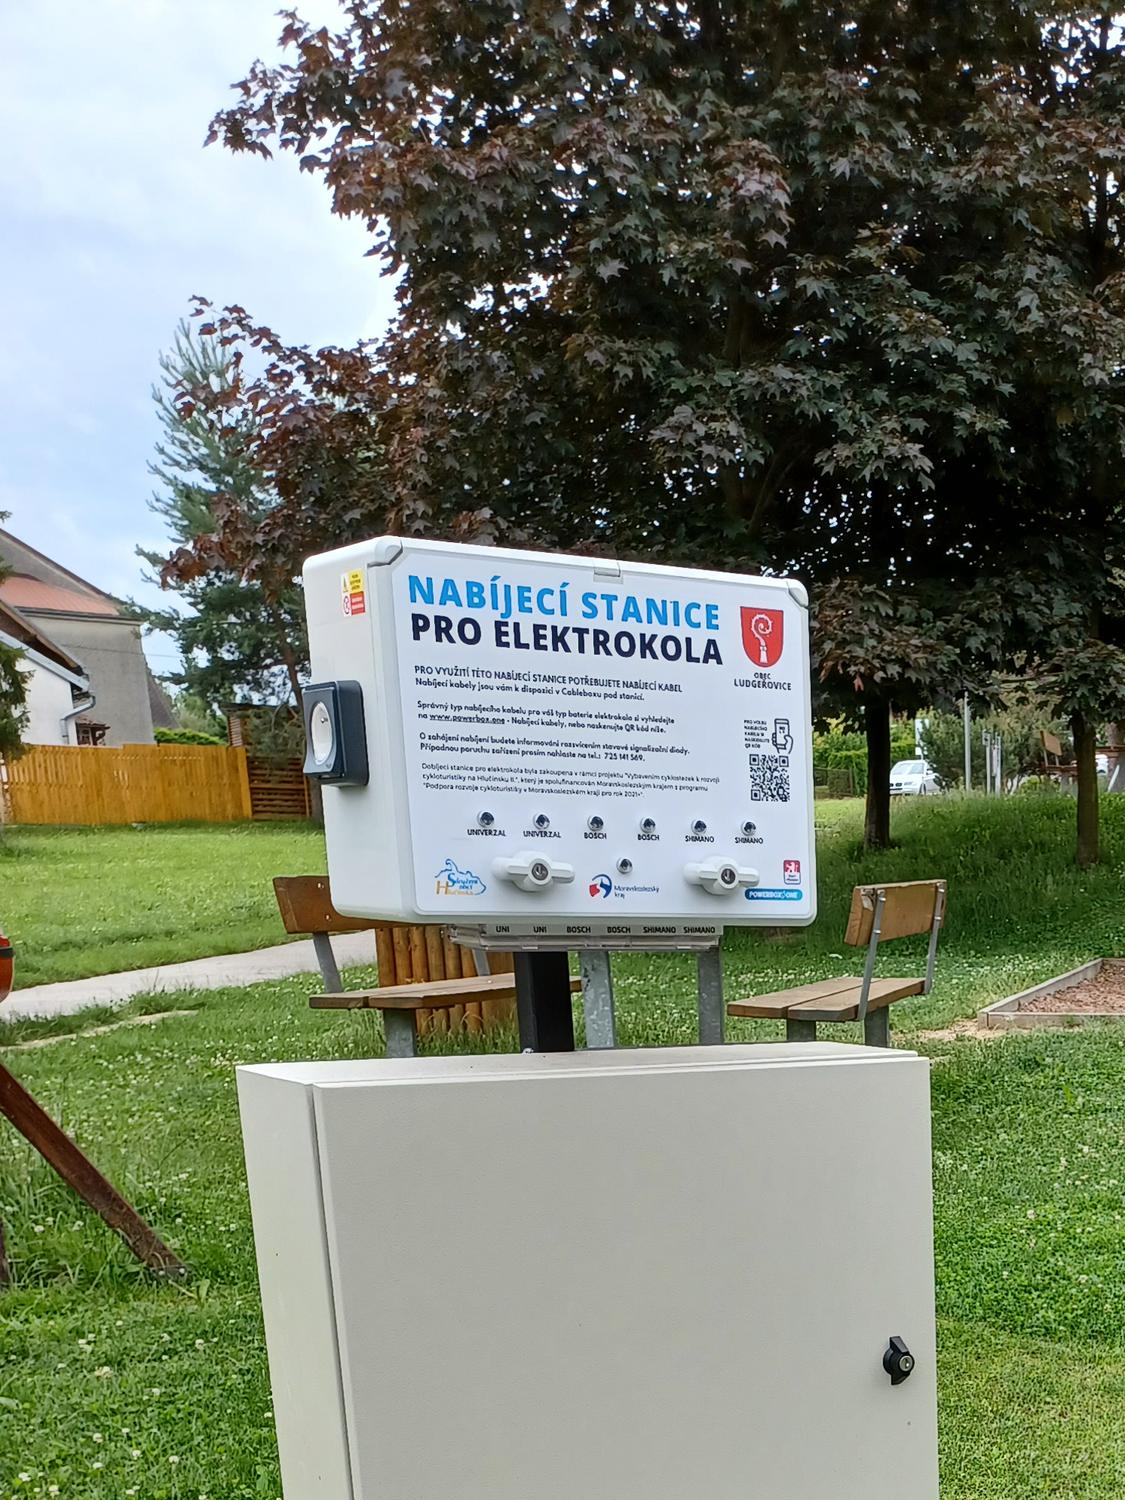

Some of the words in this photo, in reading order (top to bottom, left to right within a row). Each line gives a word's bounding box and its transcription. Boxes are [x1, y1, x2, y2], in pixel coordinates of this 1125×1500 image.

[408, 575, 570, 620] NABÍJECÍ
[581, 592, 720, 631] STANICE
[411, 613, 481, 646] PRO
[494, 620, 723, 665] ELEKTROKOLA
[415, 666, 433, 675] PRO
[435, 666, 469, 677] VYUŽITÍ
[472, 667, 492, 678] TÉTO
[494, 670, 530, 681] NABÍJECÍ
[532, 673, 566, 684] STANICE
[569, 676, 620, 688] POTŘEBUJETE
[622, 680, 656, 690] NABÍJECÍ
[658, 683, 682, 692] KABEL
[754, 672, 771, 680] OBEC
[416, 678, 448, 688] Nabíjecí
[450, 680, 476, 690] kabely
[477, 682, 493, 691] jsou
[496, 684, 512, 692] vám
[521, 685, 554, 695] dispozici
[604, 691, 617, 700] pod
[734, 678, 792, 691] LUDGEŘOVICE
[417, 700, 448, 711] Správný
[450, 702, 462, 712] typ
[464, 704, 500, 714] nabíjecího
[502, 706, 526, 715] kabelu
[556, 710, 566, 718] typ
[568, 710, 592, 719] baterie
[511, 717, 539, 727] Nabíjecí
[568, 721, 585, 729] nebo
[625, 724, 635, 732] QR
[419, 732, 426, 740] O
[491, 736, 515, 745] budete
[460, 746, 490, 754] poruchu
[467, 829, 506, 837] UNIVERZAL
[523, 830, 561, 838] UNIVERZAL
[584, 832, 607, 840] BOSCH
[685, 835, 714, 843] SHIMANO
